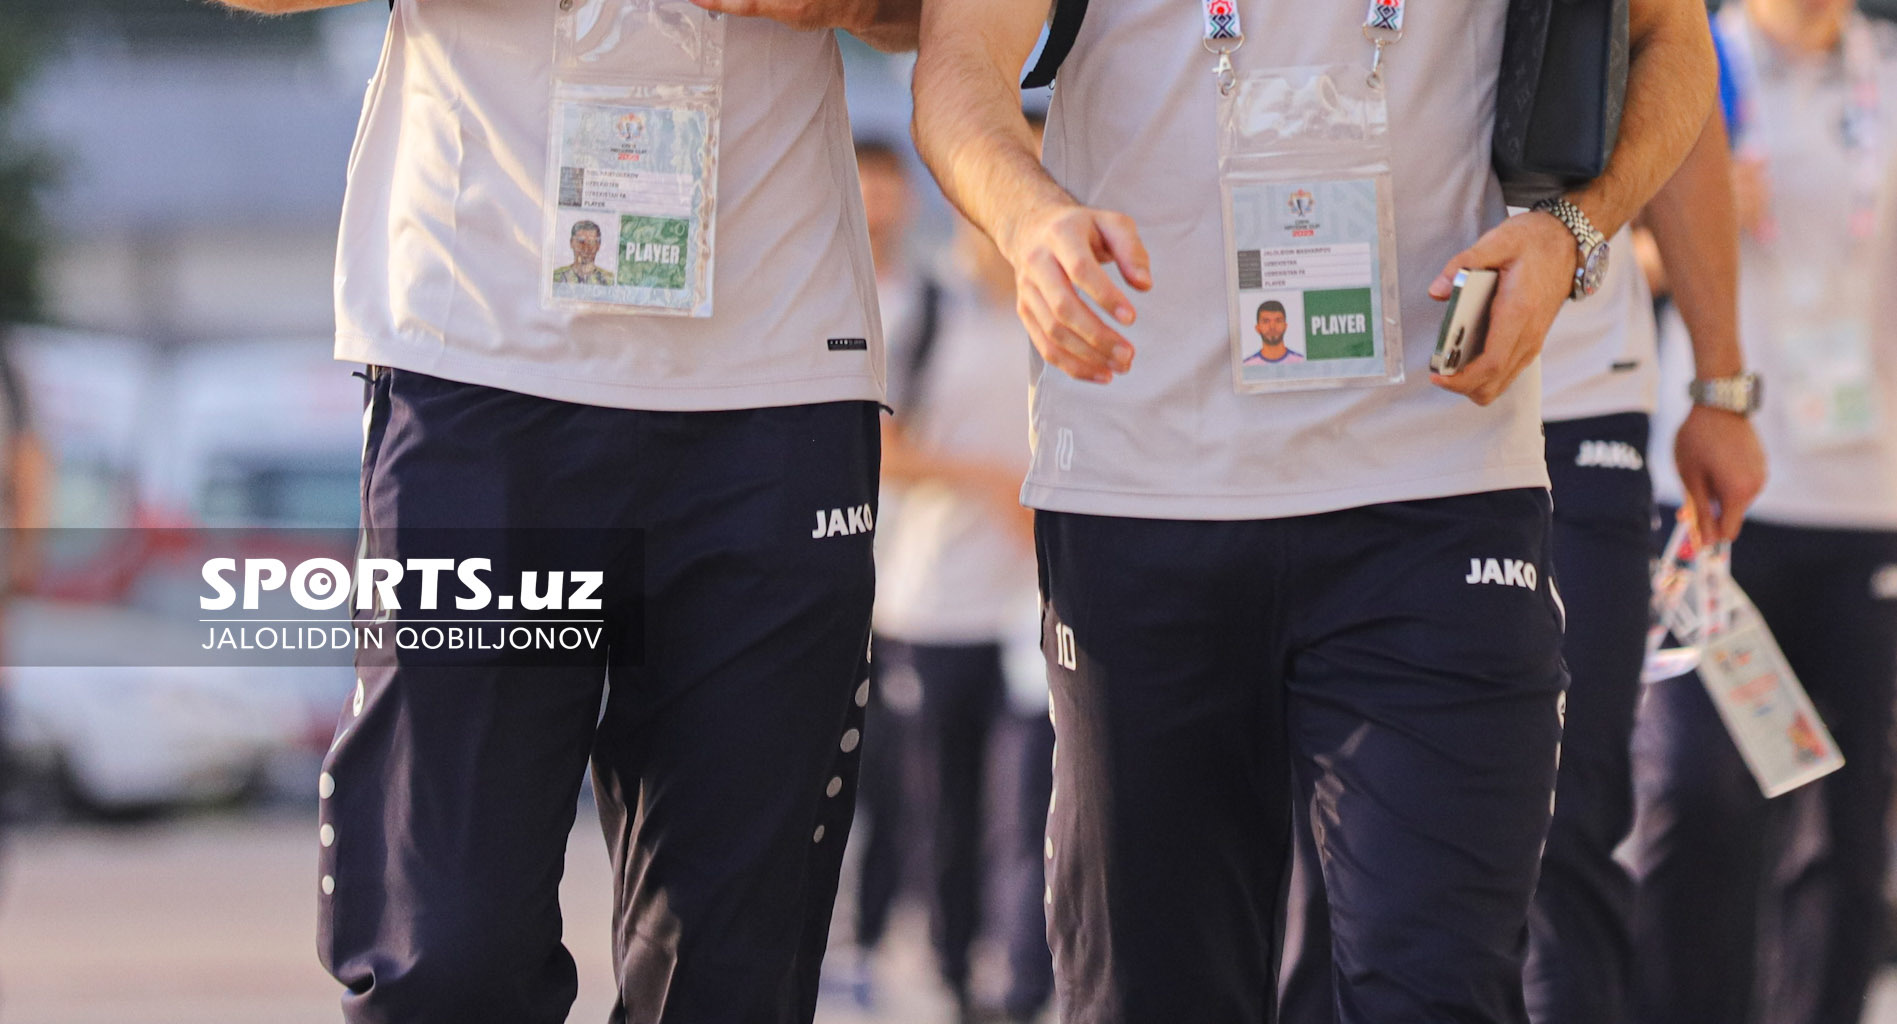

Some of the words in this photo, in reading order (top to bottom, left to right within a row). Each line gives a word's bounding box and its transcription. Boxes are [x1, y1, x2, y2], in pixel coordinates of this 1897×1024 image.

[625, 241, 681, 265] PLAYER
[1311, 313, 1366, 335] PLAYER
[811, 503, 873, 539] JAKO
[1465, 558, 1537, 591] JAKO
[1056, 621, 1077, 671] 10
